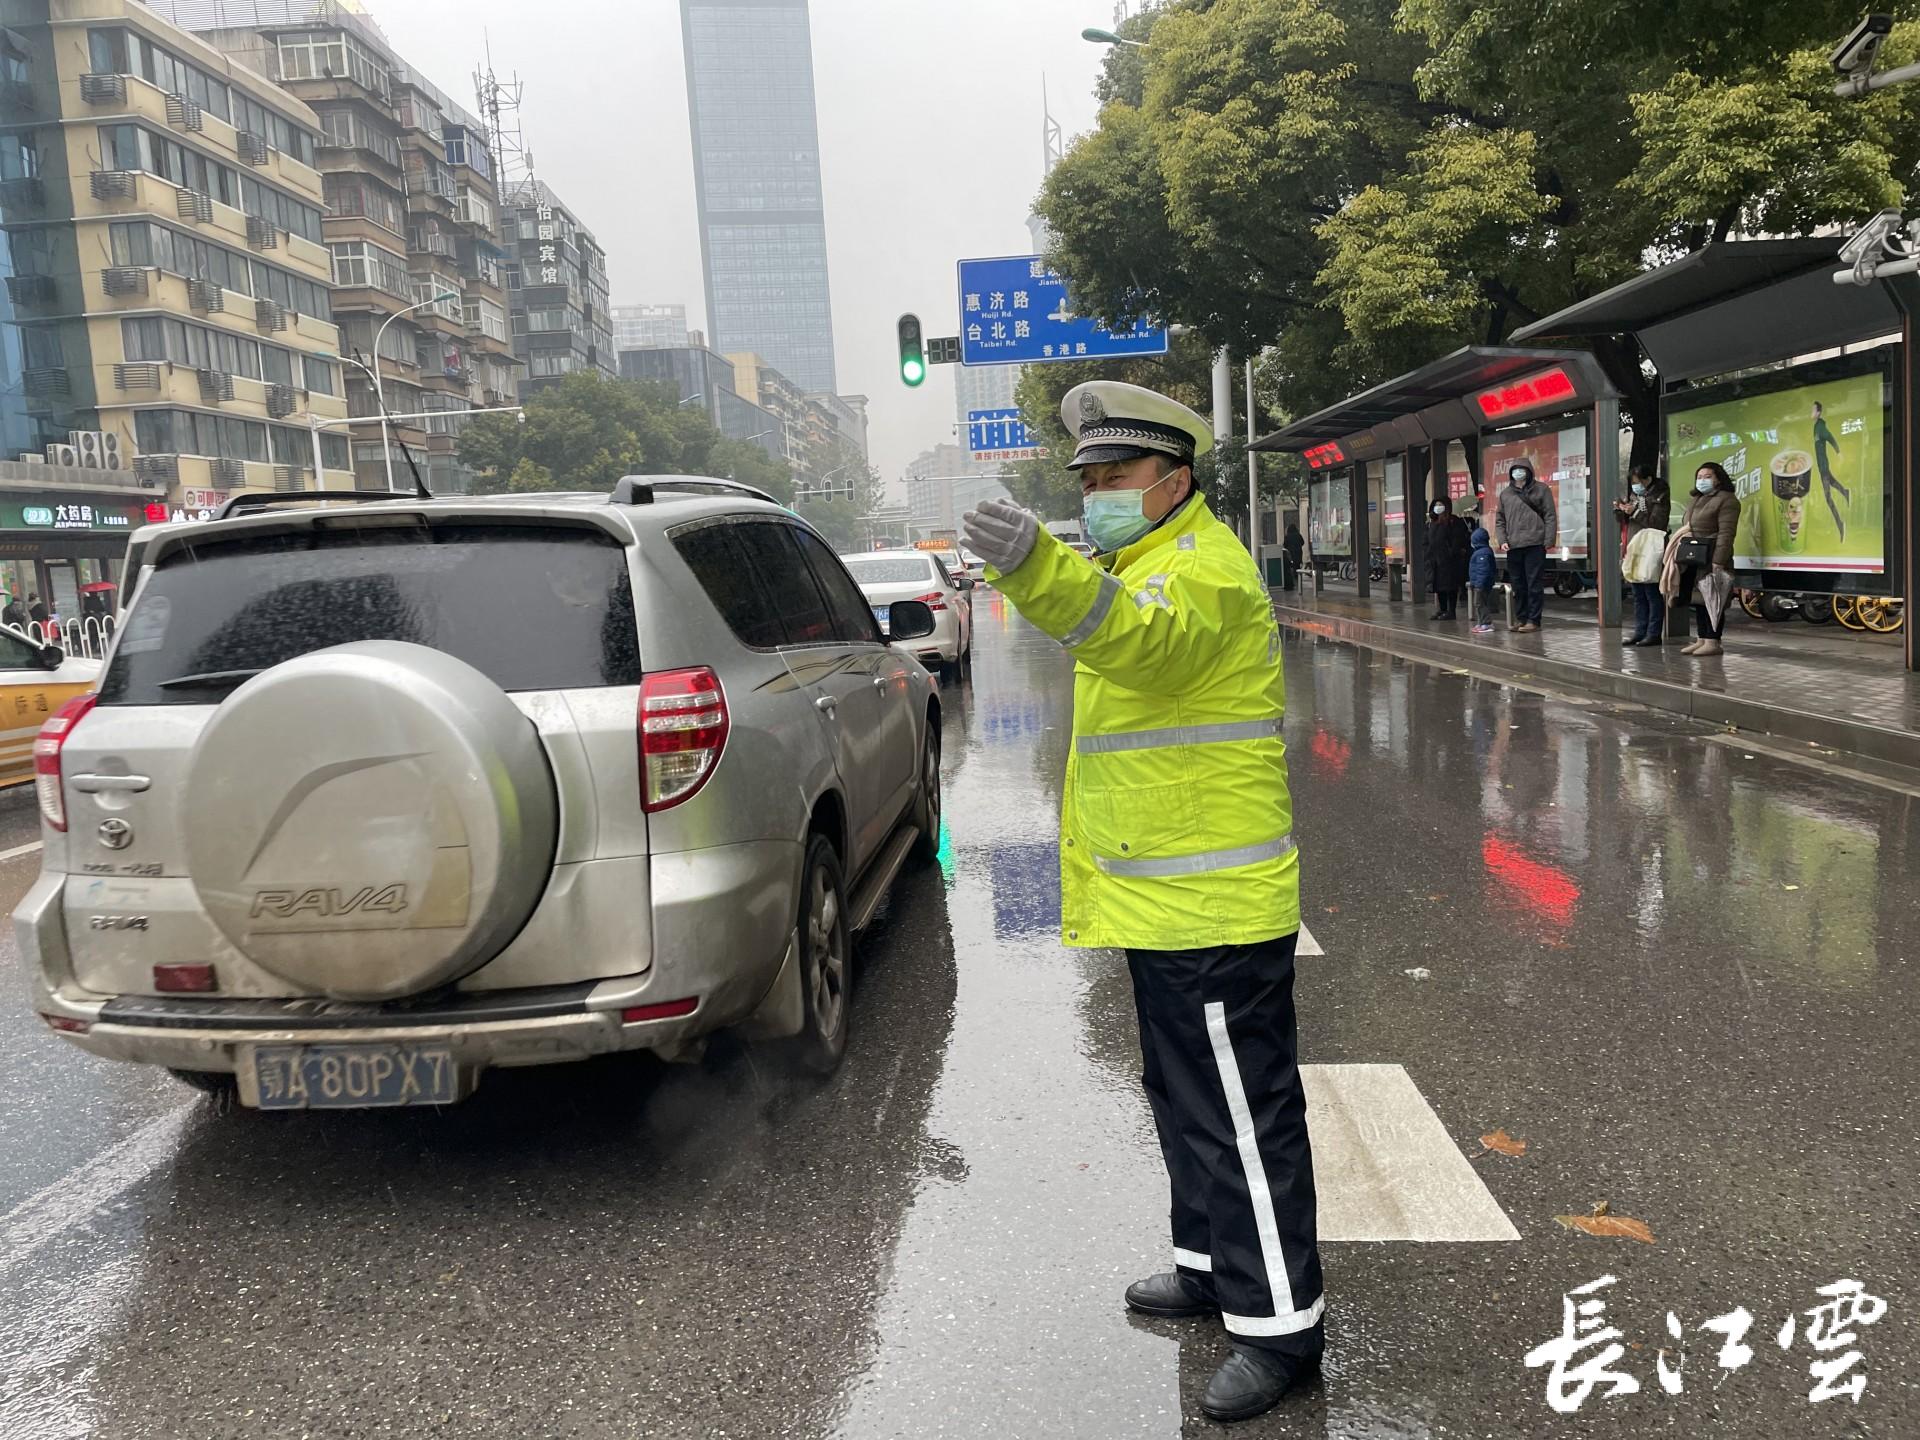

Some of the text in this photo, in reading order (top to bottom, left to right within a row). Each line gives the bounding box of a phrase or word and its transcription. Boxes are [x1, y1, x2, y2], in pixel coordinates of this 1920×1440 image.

[536, 204, 557, 284] 怡园宾馆
[965, 290, 1029, 312] 惠济路
[981, 311, 999, 319] Huiji
[967, 320, 1031, 341] 台北路
[979, 340, 1003, 348] Taibei
[1042, 342, 1088, 357] 香港路
[55, 504, 92, 521] 大药房
[248, 882, 409, 920] RAV4
